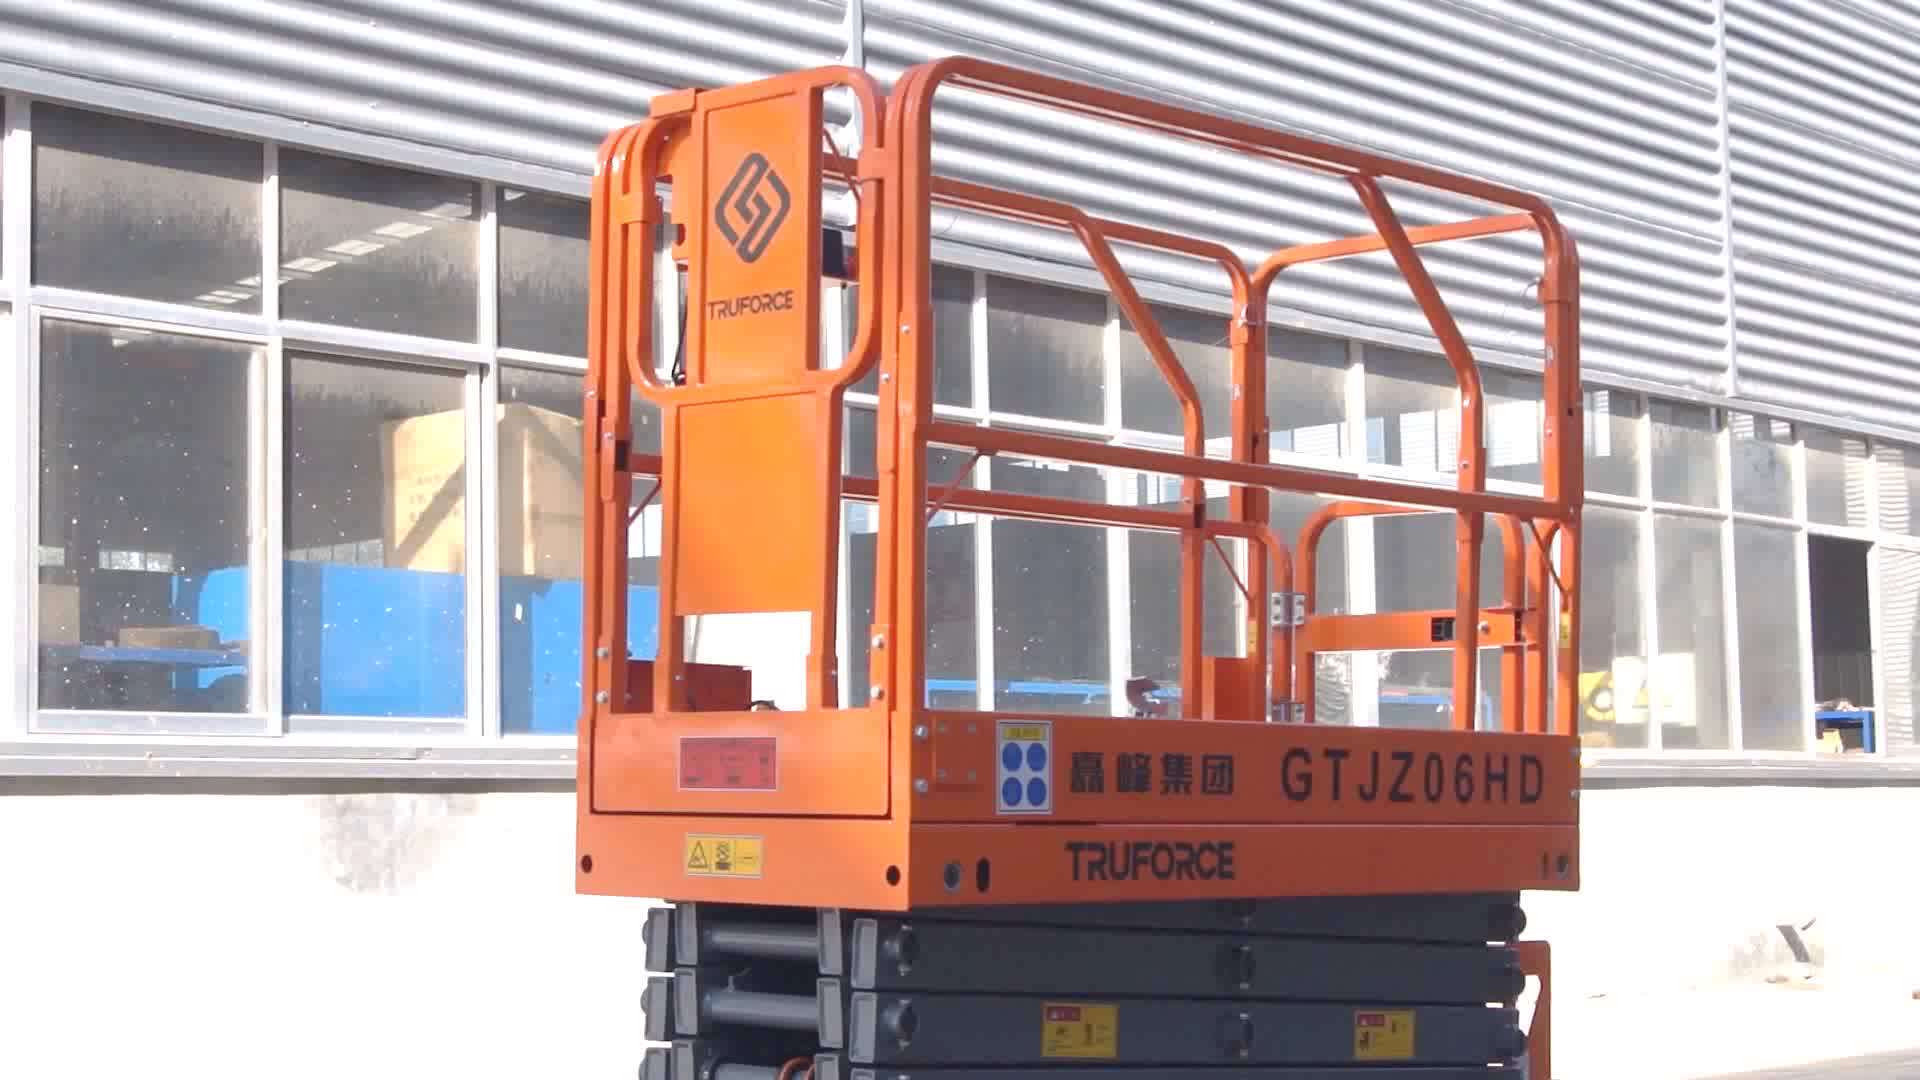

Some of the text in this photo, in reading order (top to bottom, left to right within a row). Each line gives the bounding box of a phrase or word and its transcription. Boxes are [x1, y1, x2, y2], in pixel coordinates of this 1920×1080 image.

[707, 291, 793, 320] TRUFORCE
[1281, 748, 1543, 803] GTJZ06HD
[1065, 842, 1235, 880] TRUFORCE
